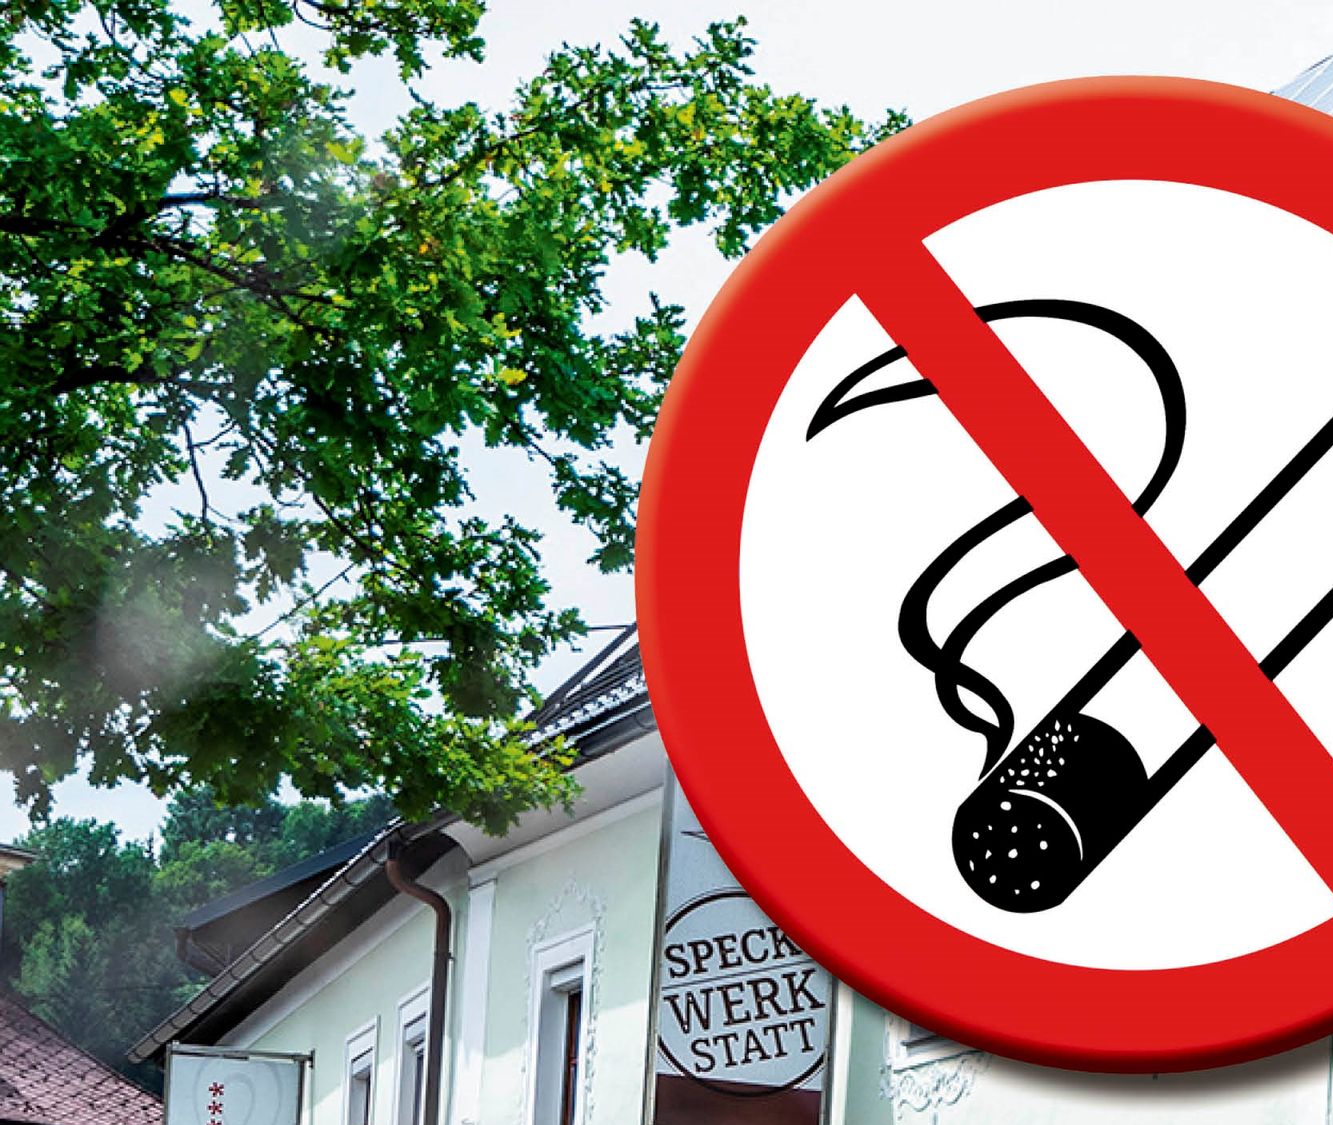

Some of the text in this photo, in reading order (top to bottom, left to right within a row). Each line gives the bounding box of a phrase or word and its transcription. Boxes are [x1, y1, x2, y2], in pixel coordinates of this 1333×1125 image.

[664, 926, 803, 979] SPECK
[663, 967, 826, 1034] WERK
[690, 1018, 816, 1073] STATT
